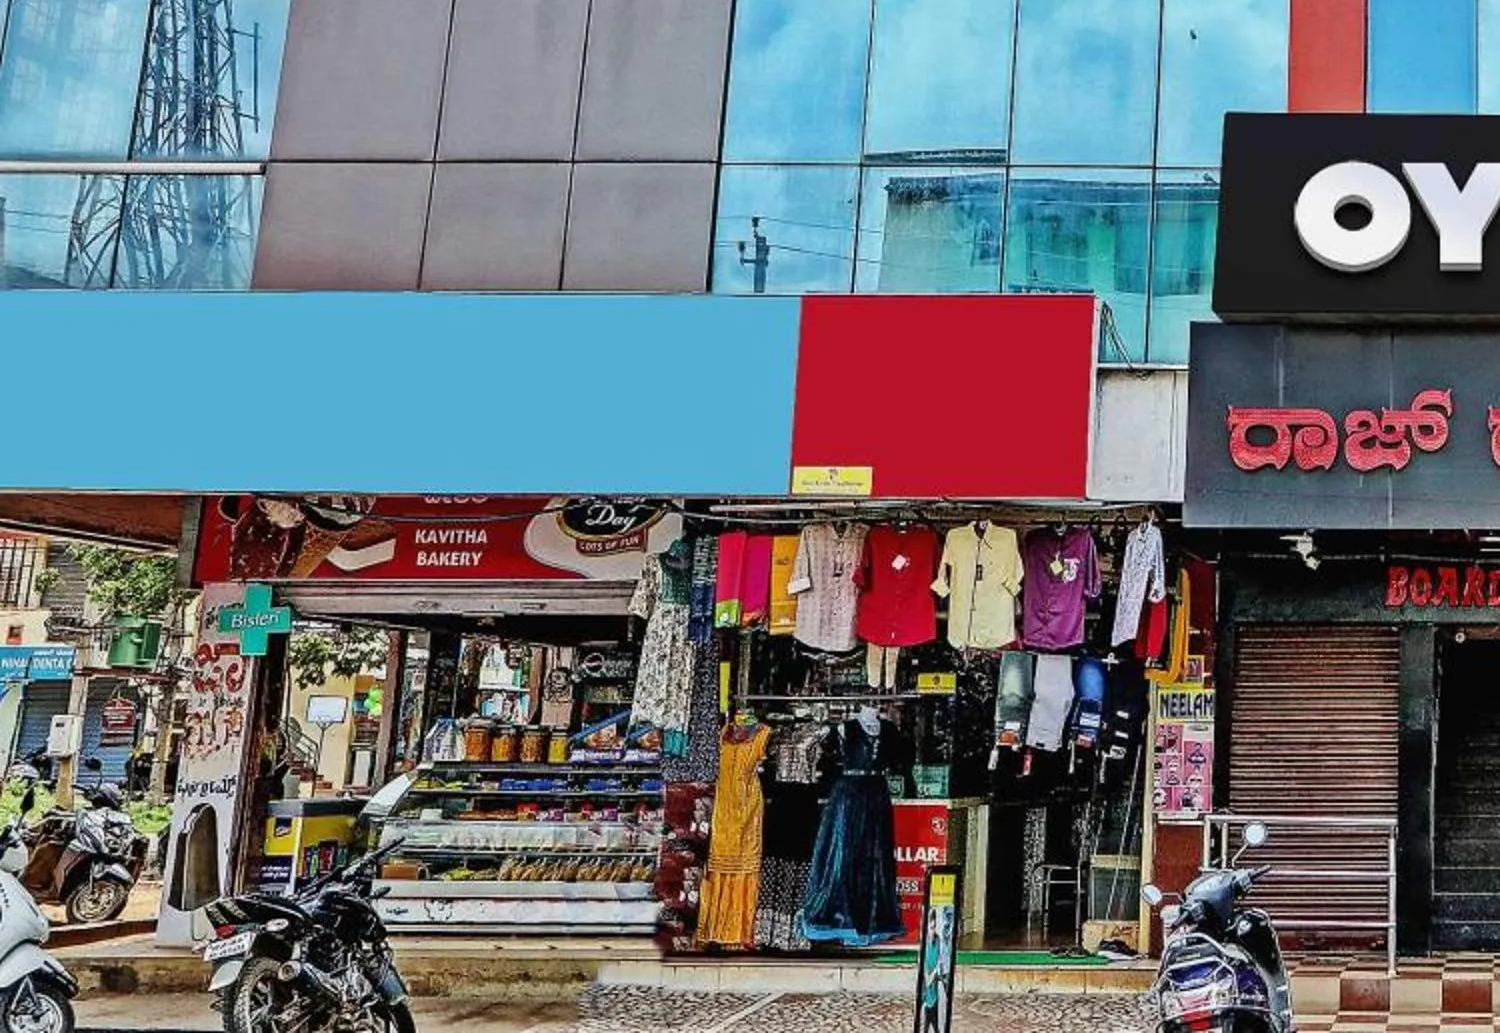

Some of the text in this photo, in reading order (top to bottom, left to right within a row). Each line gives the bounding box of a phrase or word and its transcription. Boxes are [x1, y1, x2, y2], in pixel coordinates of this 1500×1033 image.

[1226, 387, 1453, 474] ರಾಜ್
[585, 504, 637, 535] Day
[414, 528, 488, 544] KAVITHA
[416, 551, 483, 566] BAKERY
[231, 611, 279, 628] Bisleri
[1160, 692, 1214, 718] NEELAM
[893, 846, 939, 862] LLAR
